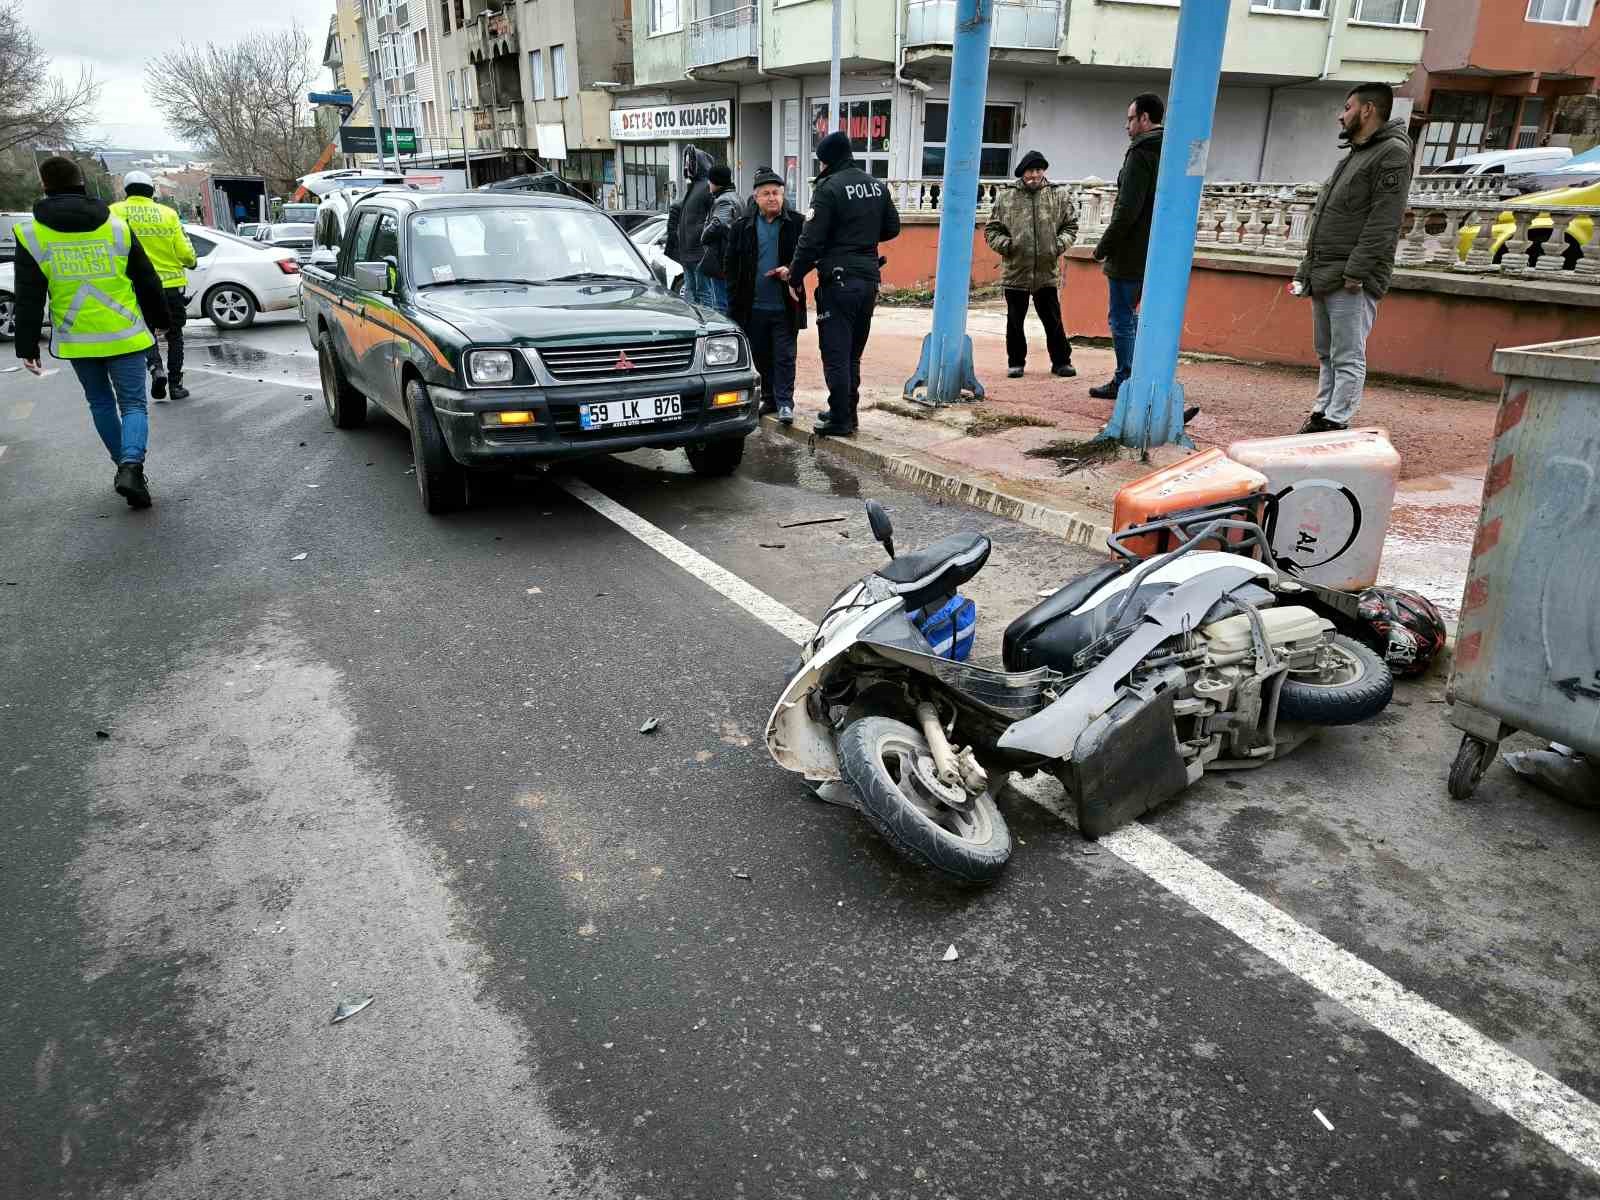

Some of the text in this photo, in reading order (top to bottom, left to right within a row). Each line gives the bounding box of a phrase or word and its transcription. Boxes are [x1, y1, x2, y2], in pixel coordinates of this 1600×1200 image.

[655, 111, 676, 128] OTO
[679, 104, 727, 126] KUAFÖR
[590, 397, 680, 423] 59 LK 876
